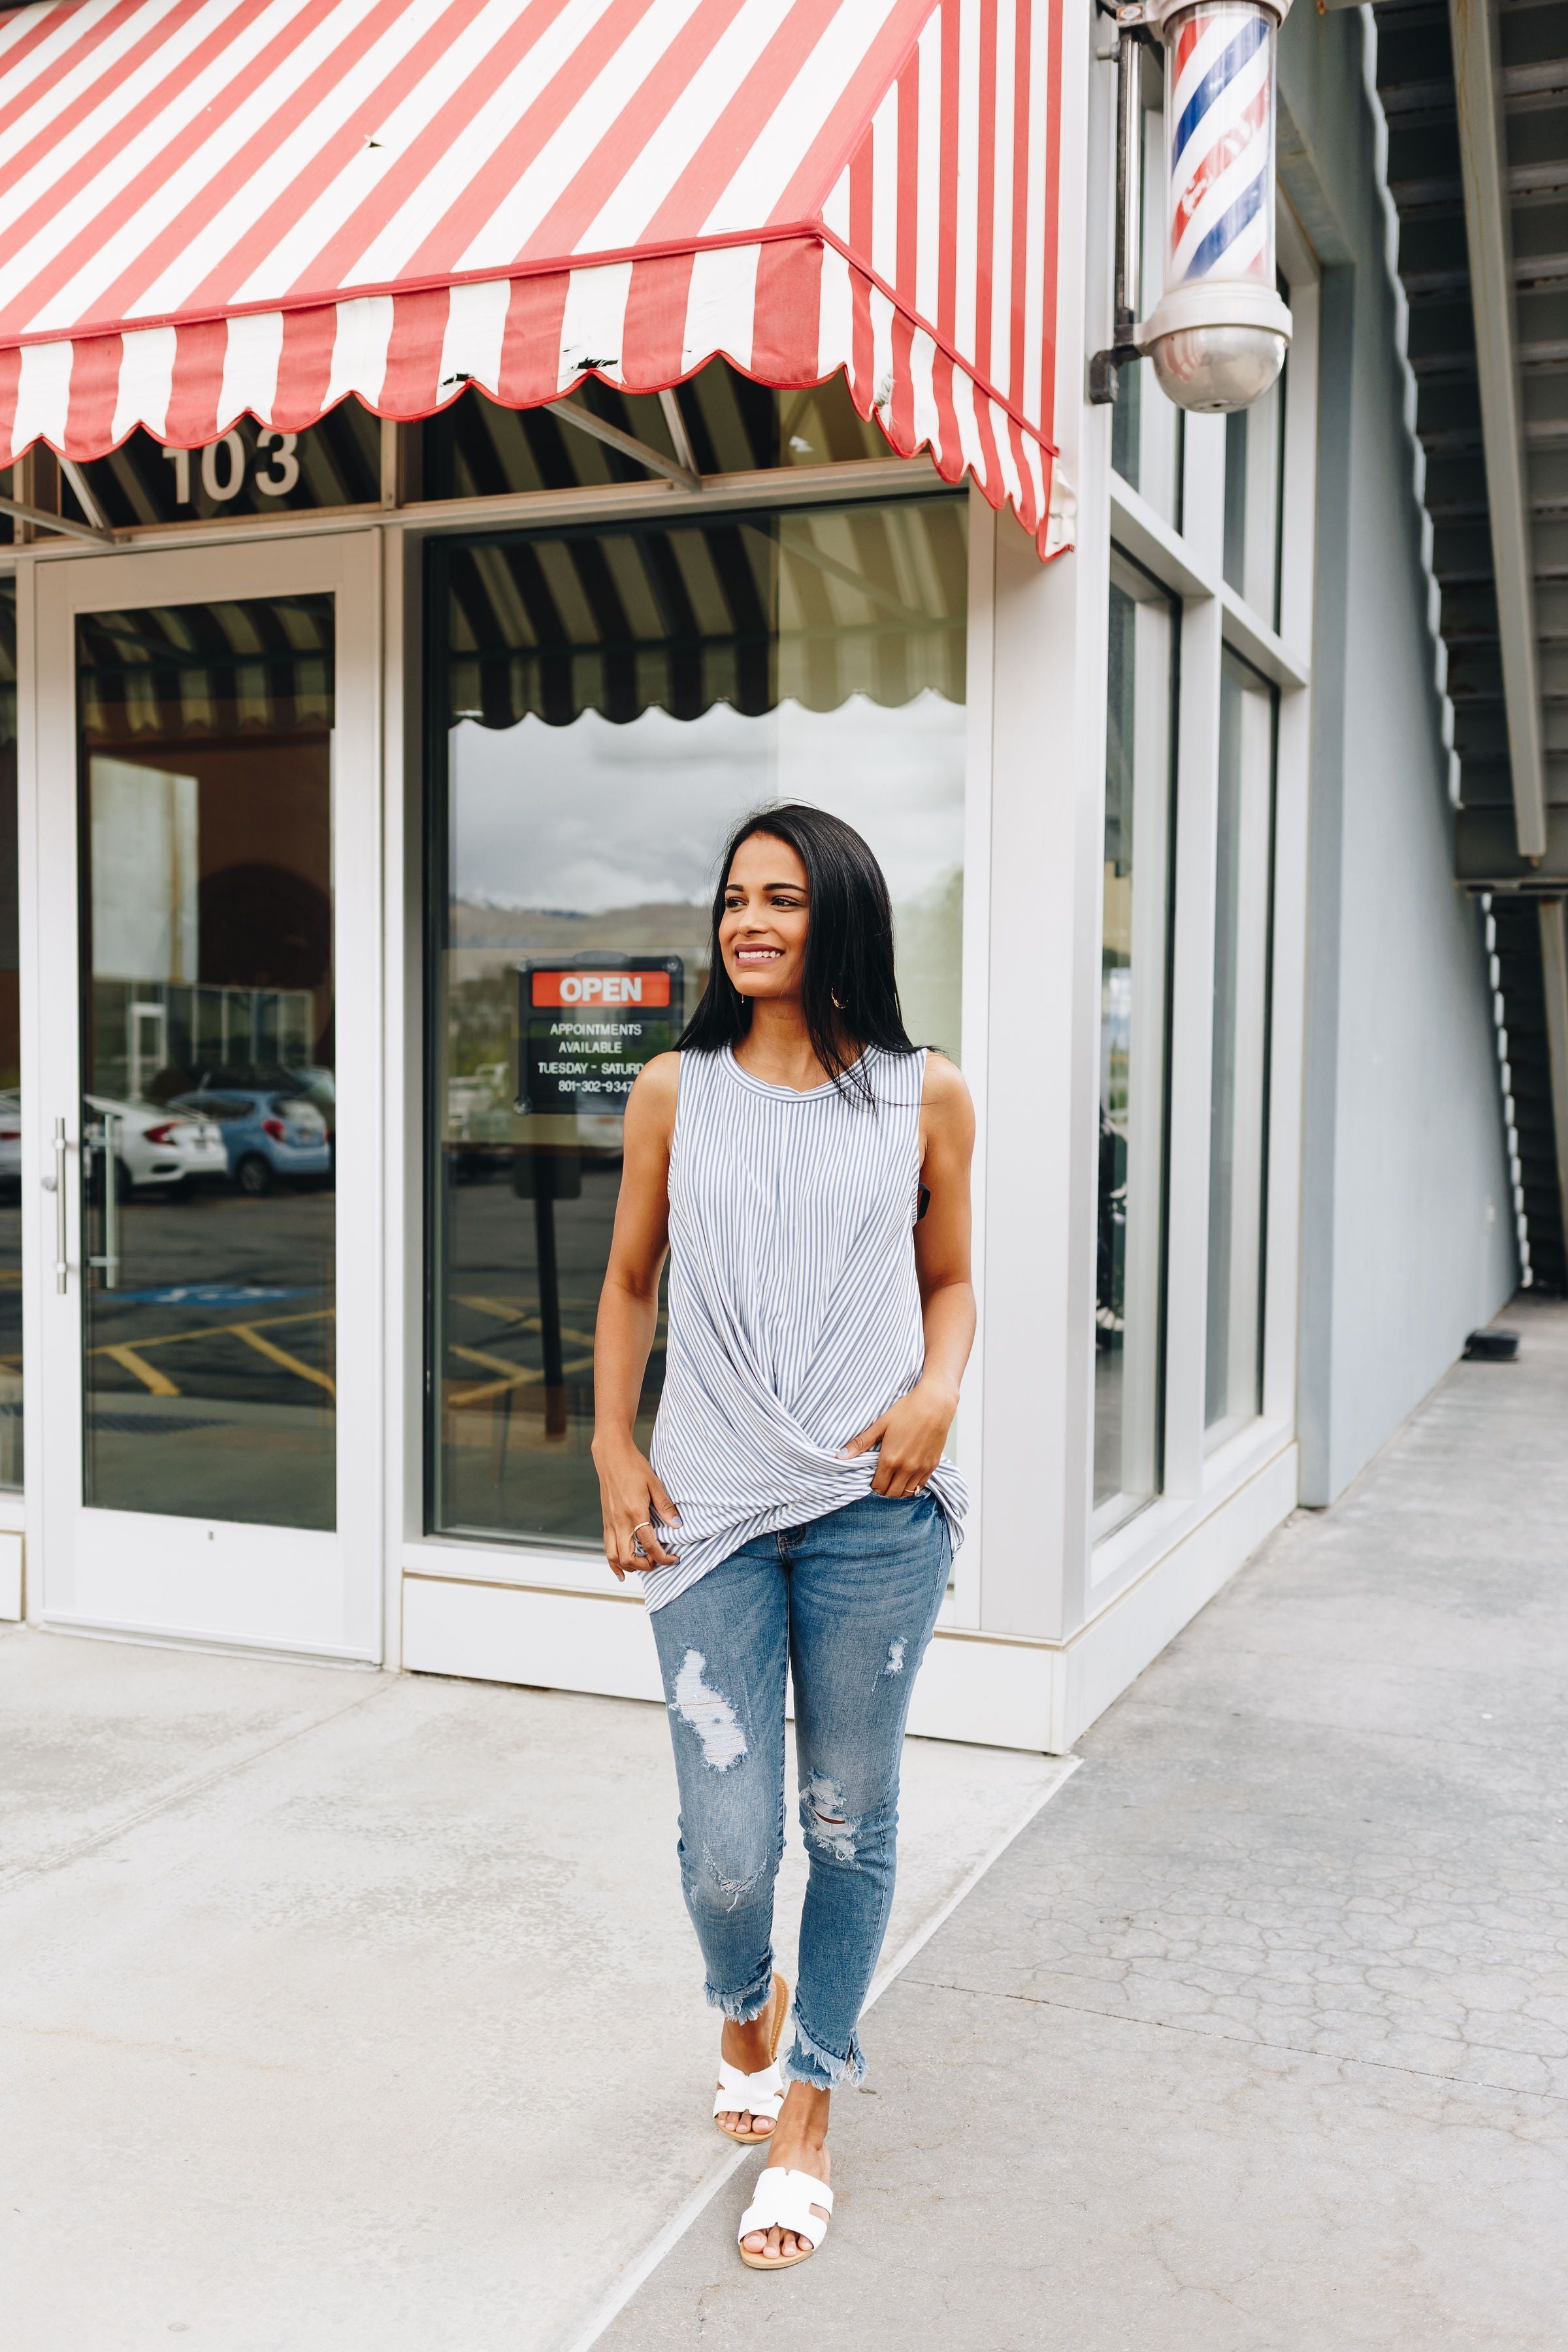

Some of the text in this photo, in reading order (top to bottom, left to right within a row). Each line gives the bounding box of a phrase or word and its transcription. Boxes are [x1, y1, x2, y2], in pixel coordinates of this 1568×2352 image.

[162, 428, 300, 504] 103
[560, 977, 642, 1002] OPEN
[550, 1023, 642, 1036] APPOINTMENTS
[559, 1041, 623, 1054] AVAILABLE
[538, 1062, 589, 1074] TUESDAY
[600, 1062, 644, 1075] SATURD
[558, 1081, 634, 1093] 801-302-9347
